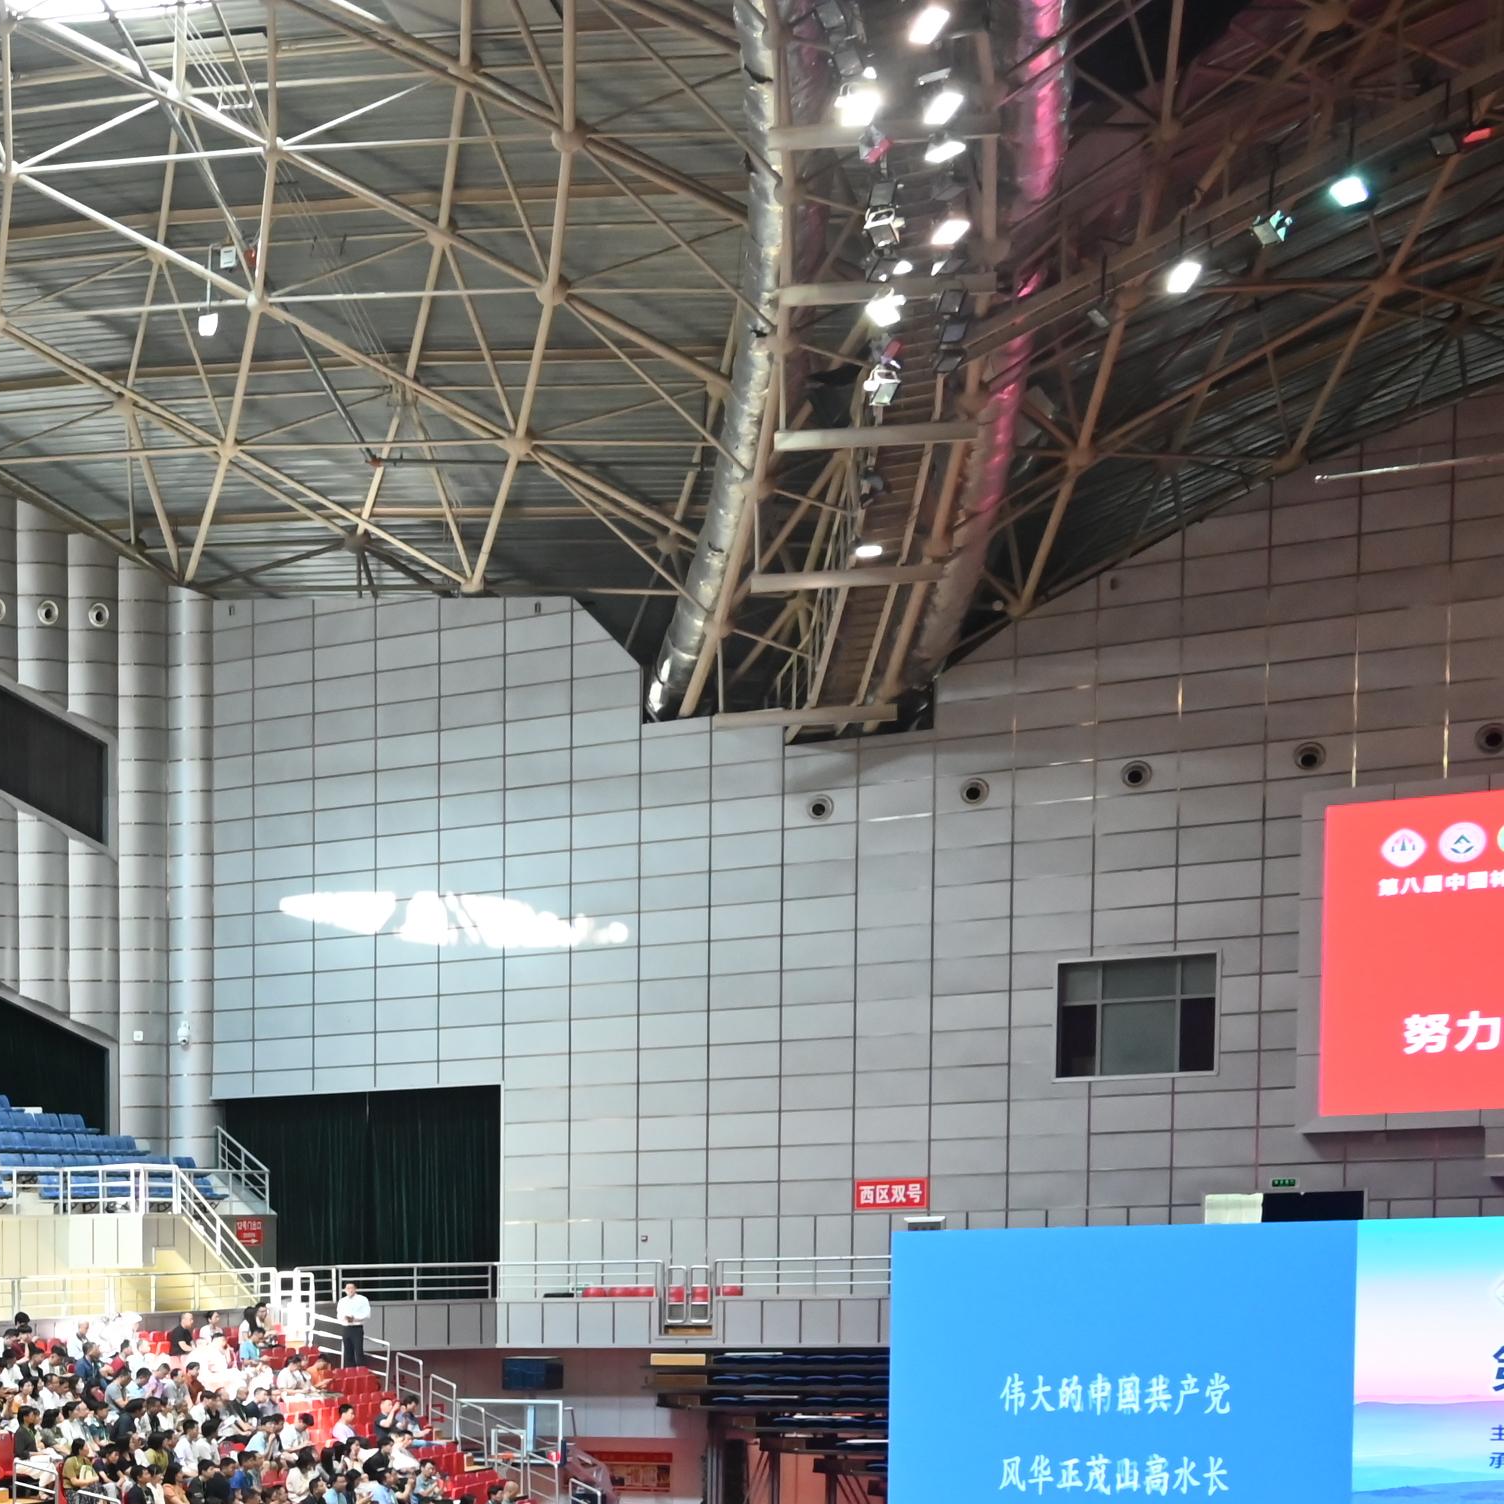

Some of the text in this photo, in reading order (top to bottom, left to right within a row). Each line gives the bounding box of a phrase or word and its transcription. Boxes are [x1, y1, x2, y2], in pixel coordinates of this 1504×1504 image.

[1402, 1010, 1502, 1055] 努力
[858, 1183, 923, 1205] 西区双号
[999, 1372, 1231, 1417] 伟大的中国共产党
[997, 1453, 1230, 1497] 风华正茂山高水长
